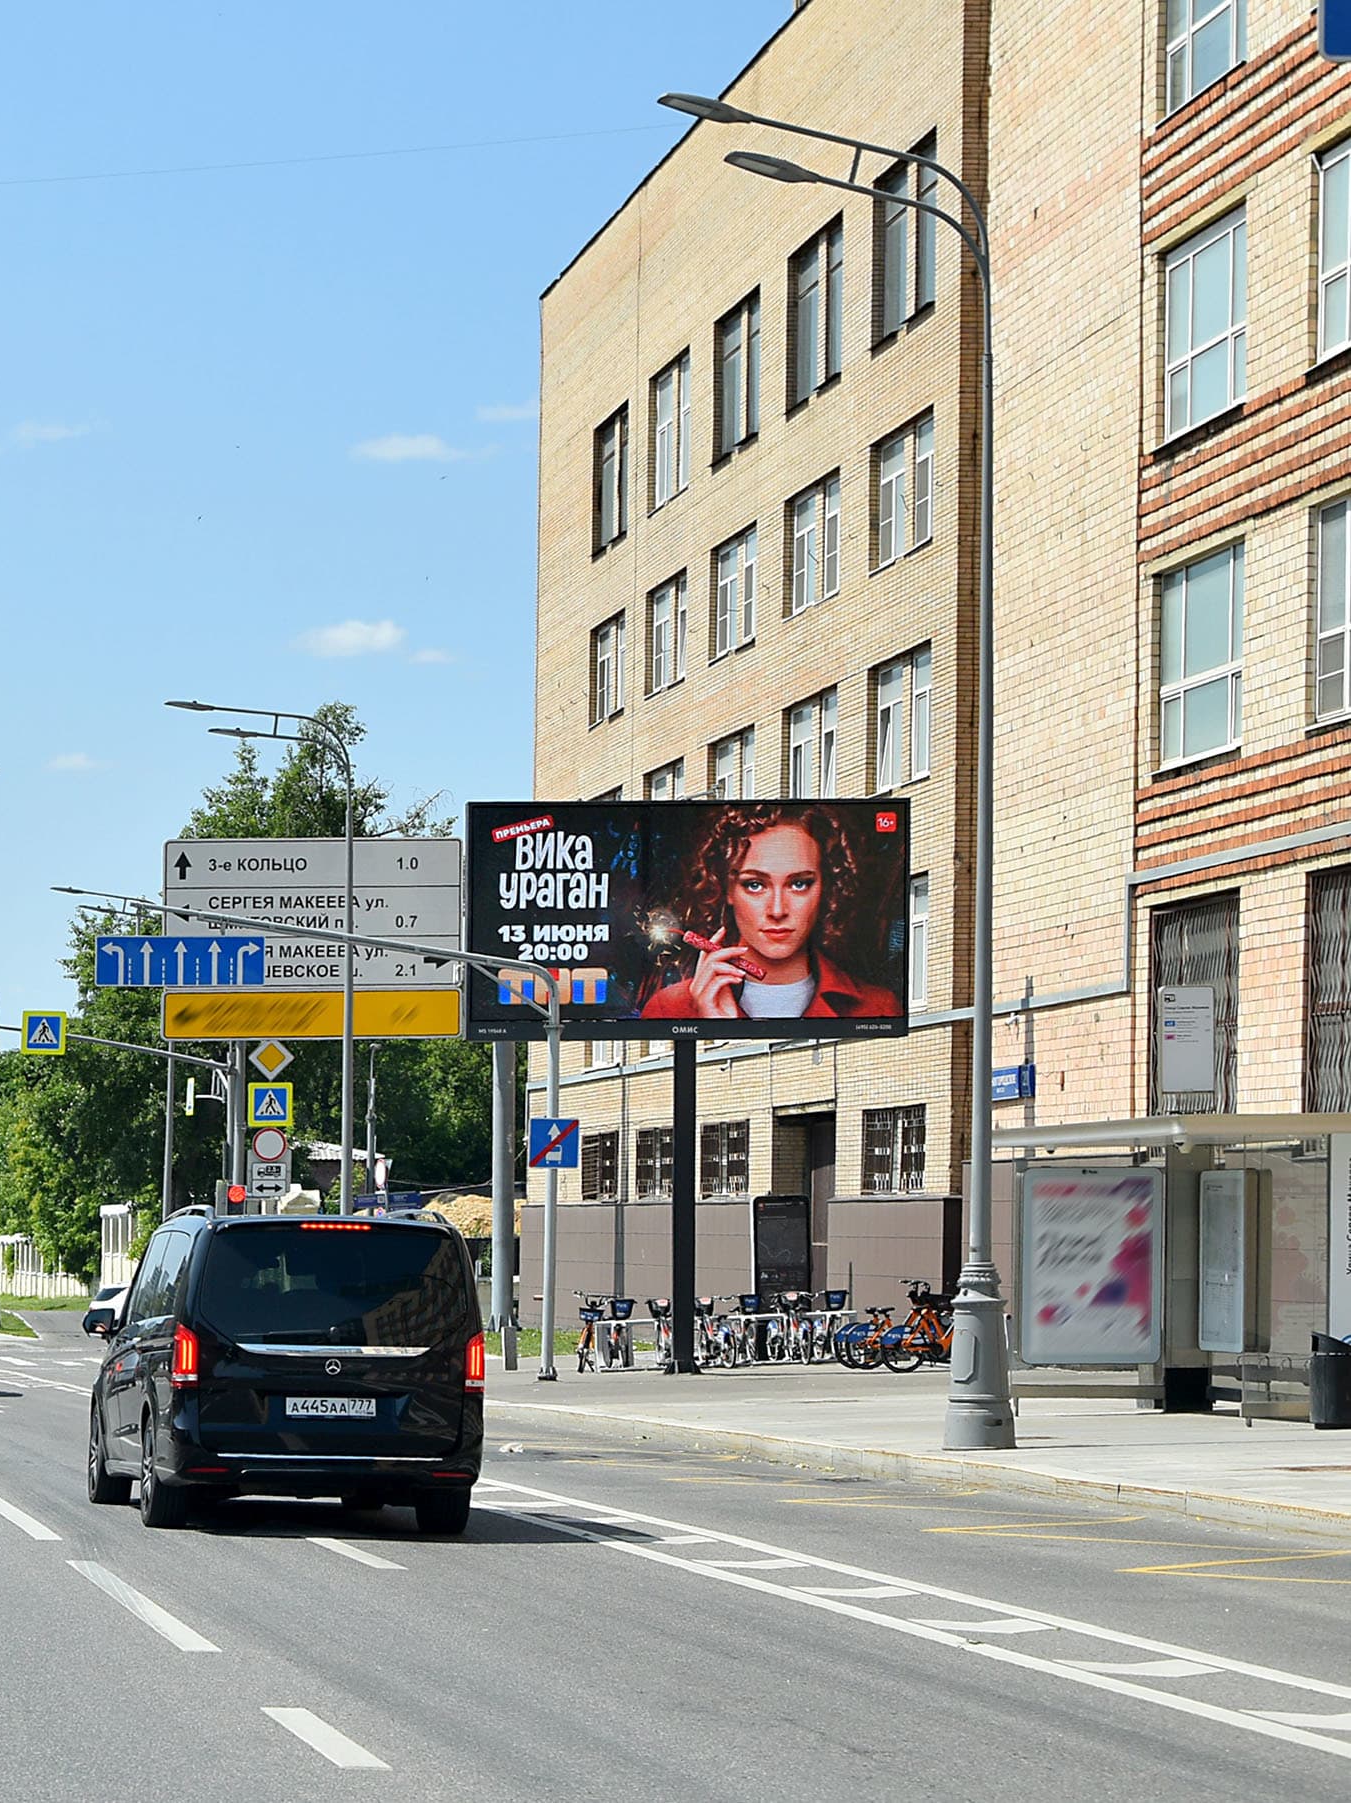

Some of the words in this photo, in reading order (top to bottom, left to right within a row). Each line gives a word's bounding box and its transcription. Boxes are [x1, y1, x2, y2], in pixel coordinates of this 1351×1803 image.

[495, 817, 551, 839] ПРЕМЬЕРА
[237, 857, 308, 873] КОЛЬЦО
[396, 857, 419, 870] 1.0
[208, 896, 274, 910] СЕРГЕЯ
[365, 898, 389, 911] ул.
[395, 915, 418, 928] 0.7
[497, 924, 527, 943] 13
[365, 947, 389, 961] ул.
[517, 943, 590, 961] 20:00
[395, 963, 416, 977] 2.1
[498, 967, 609, 1005] ТНТ
[291, 1399, 347, 1414] А445АА
[350, 1399, 372, 1411] 777
